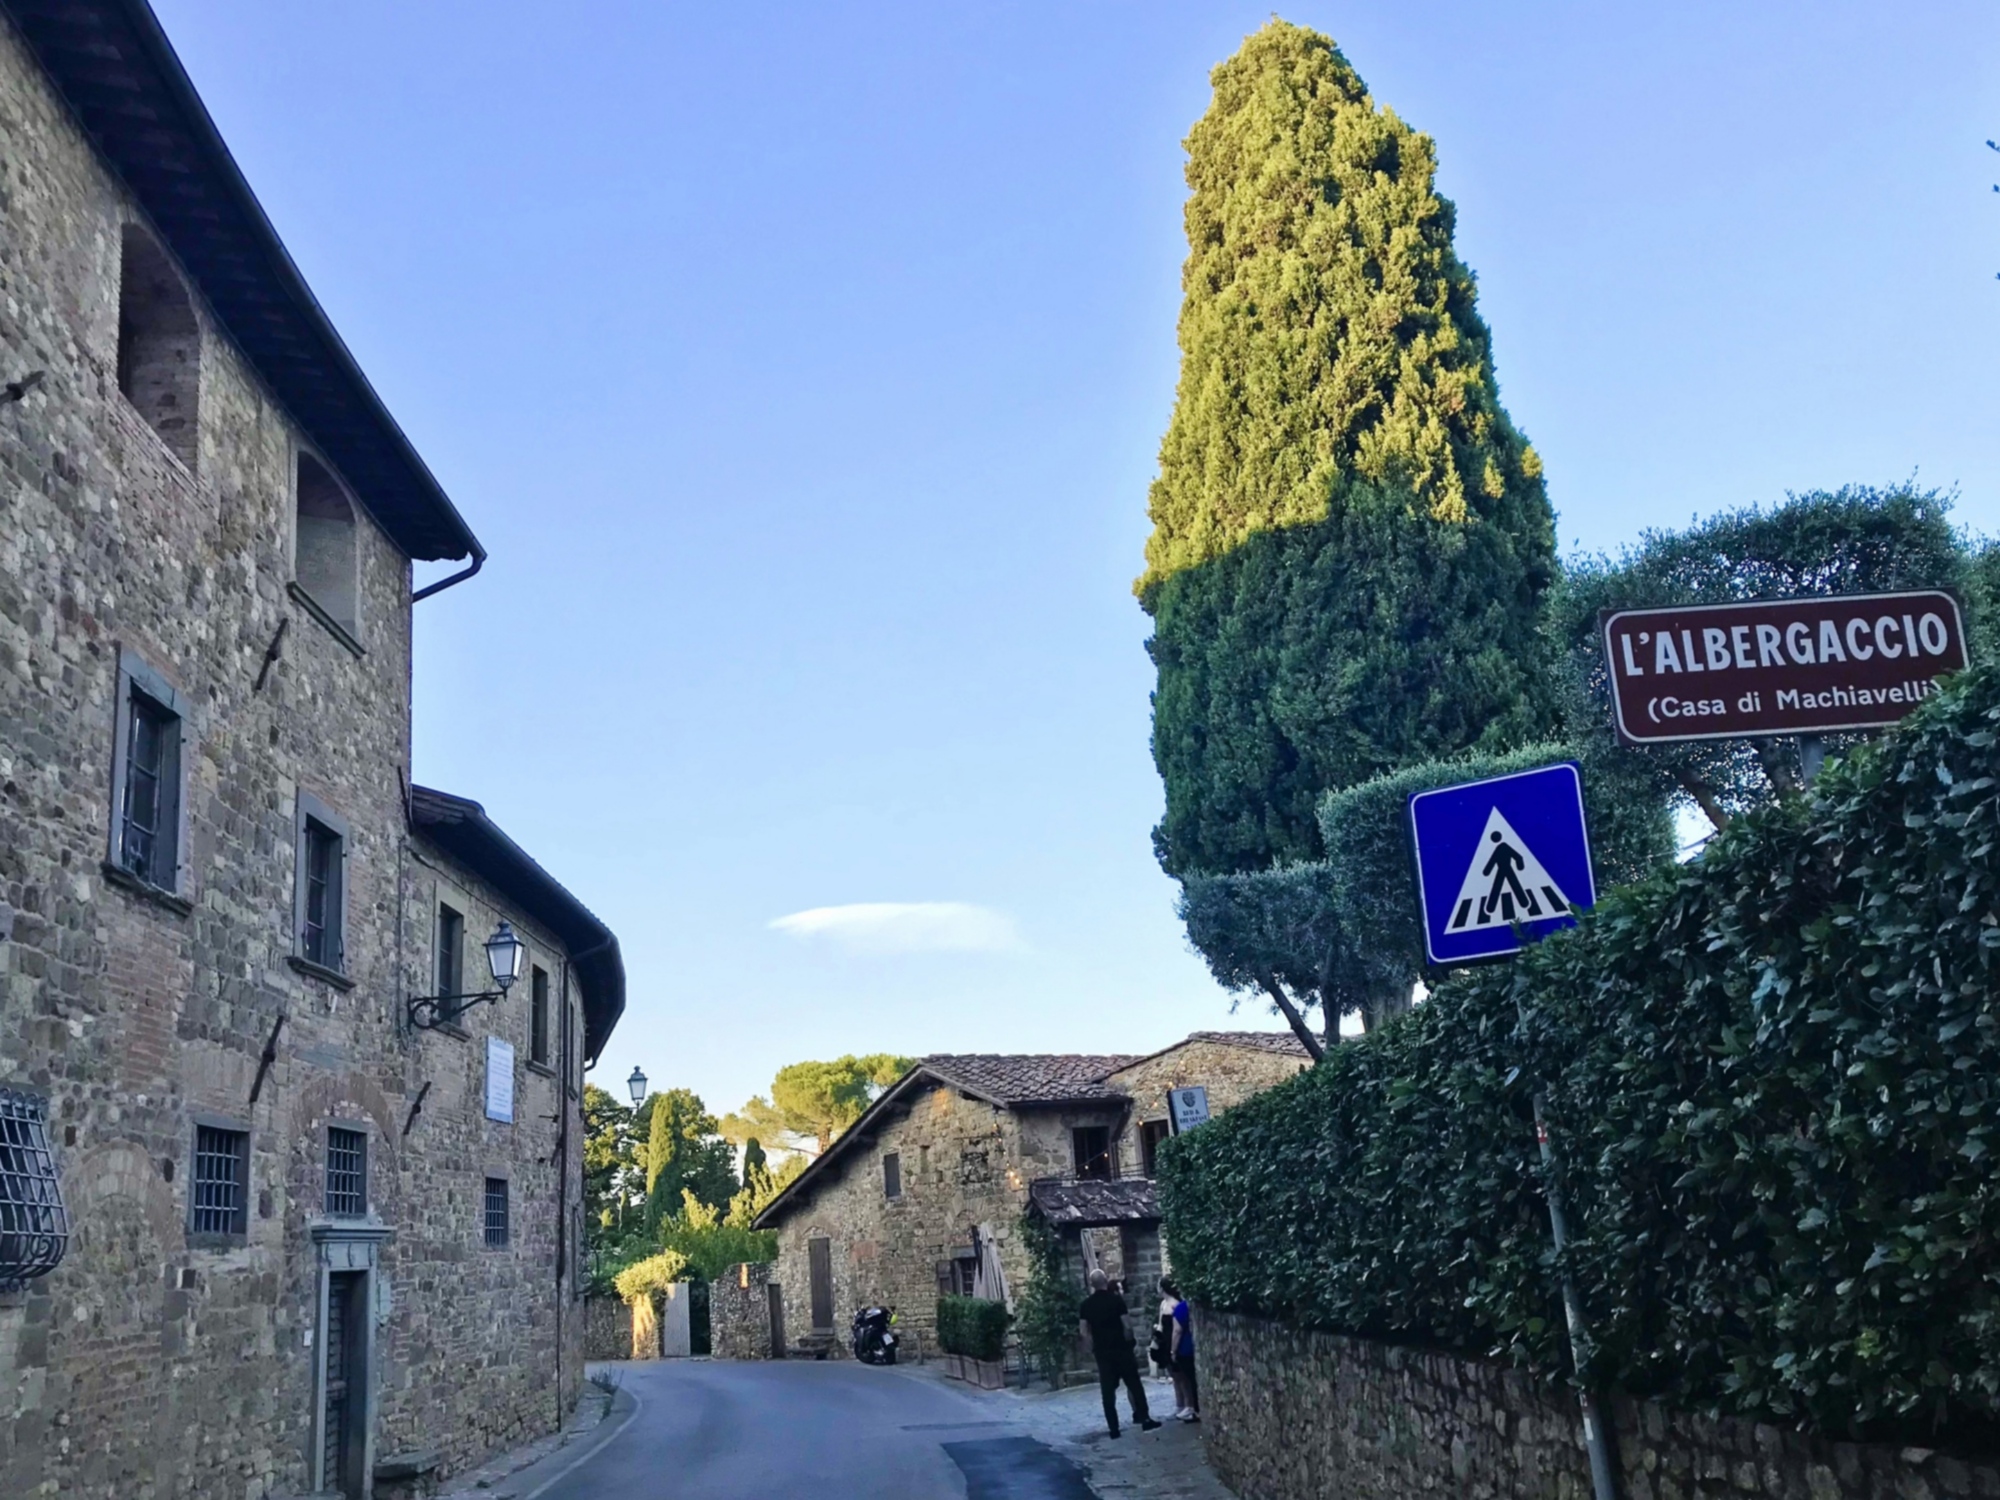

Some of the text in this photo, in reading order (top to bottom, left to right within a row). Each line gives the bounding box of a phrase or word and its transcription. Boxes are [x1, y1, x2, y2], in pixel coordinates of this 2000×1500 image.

[1620, 612, 1948, 676] L'ALBERGACCIO
[1648, 696, 1726, 723] (Casa
[1737, 692, 1761, 713] di
